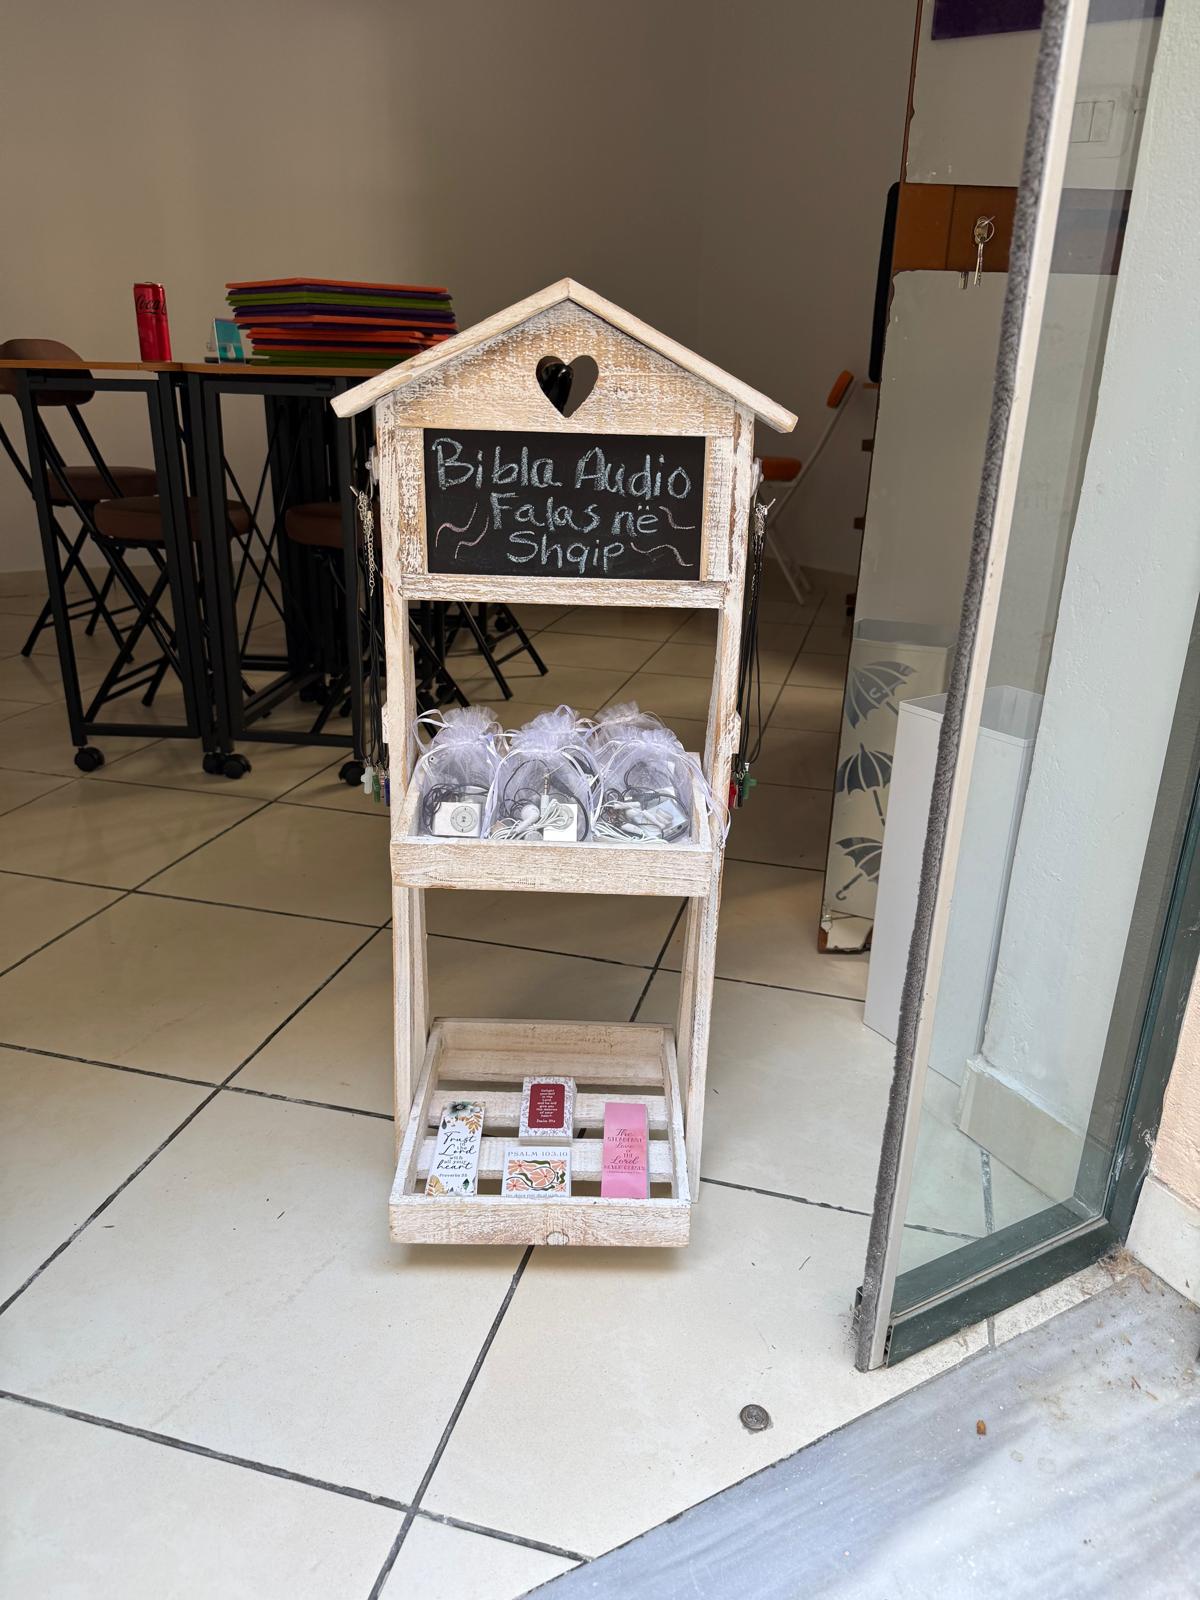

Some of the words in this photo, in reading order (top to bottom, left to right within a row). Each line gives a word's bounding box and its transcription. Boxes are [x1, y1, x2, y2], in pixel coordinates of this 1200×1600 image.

[432, 437, 563, 490] Bibla
[575, 447, 691, 500] Audio
[490, 492, 600, 533] Falas
[611, 504, 659, 537] në
[507, 530, 625, 574] Shqip
[438, 1144, 476, 1156] Lord
[443, 1130, 477, 1144] Trust
[437, 1160, 472, 1170] heart
